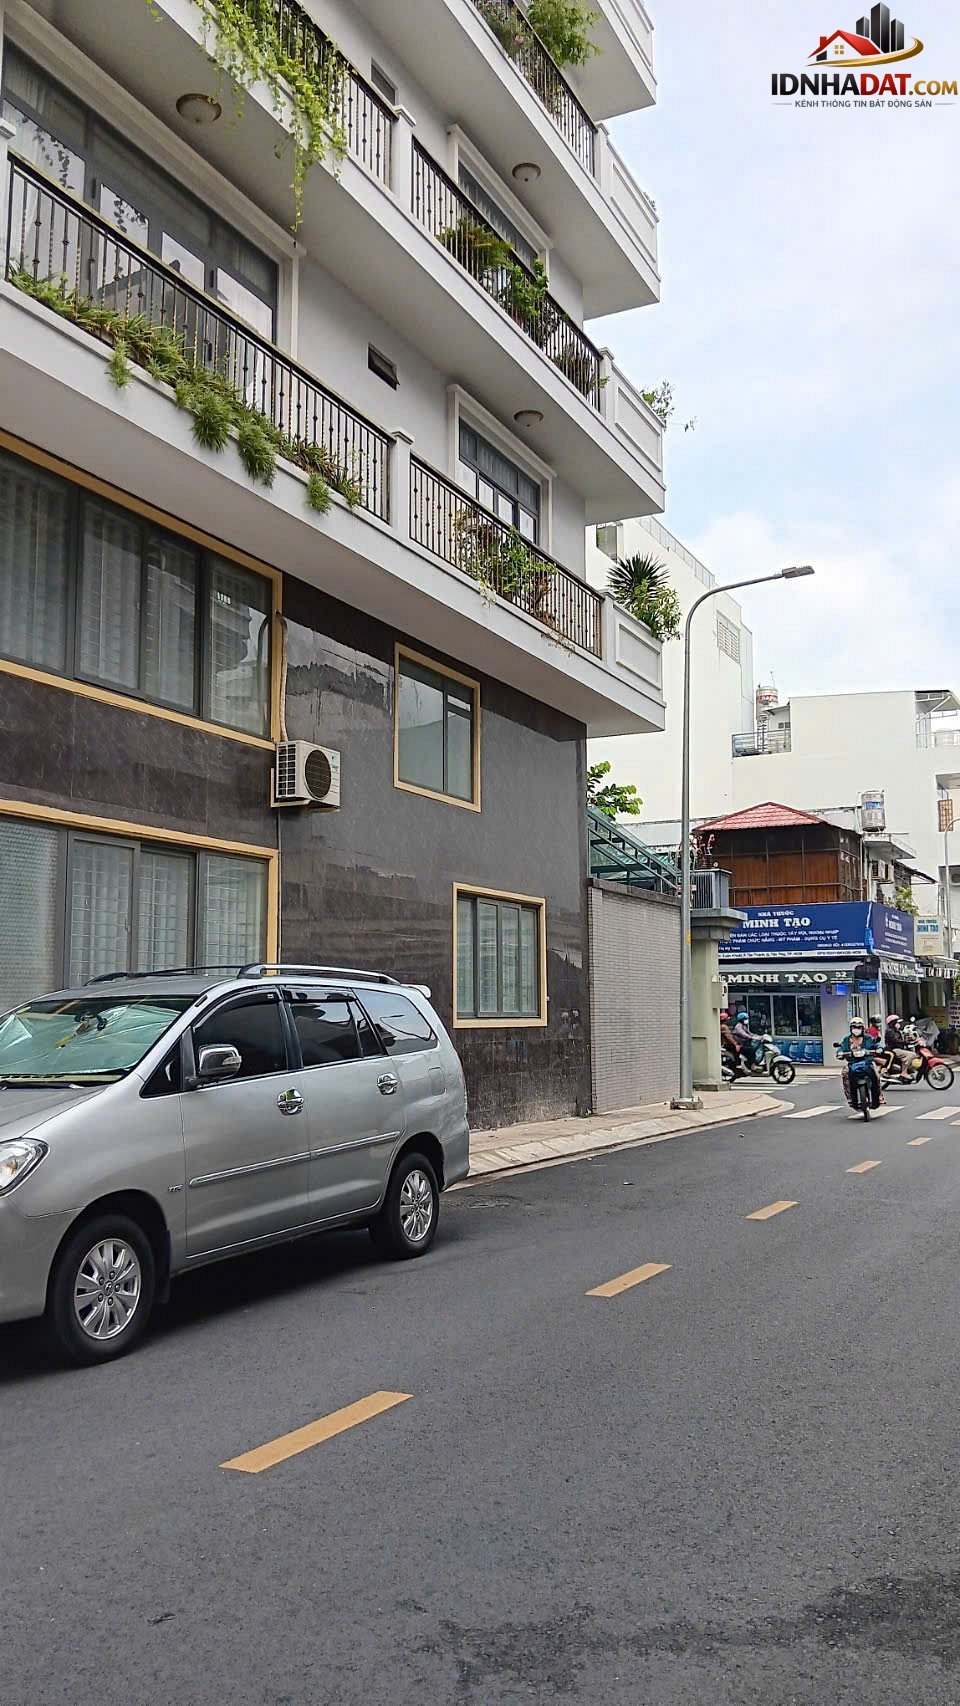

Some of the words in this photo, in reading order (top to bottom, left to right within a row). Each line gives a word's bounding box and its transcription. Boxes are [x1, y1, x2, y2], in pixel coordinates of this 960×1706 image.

[742, 918, 779, 929] MINH
[783, 917, 811, 928] TẠO
[727, 974, 780, 984] MINH
[784, 973, 828, 985] TẠO
